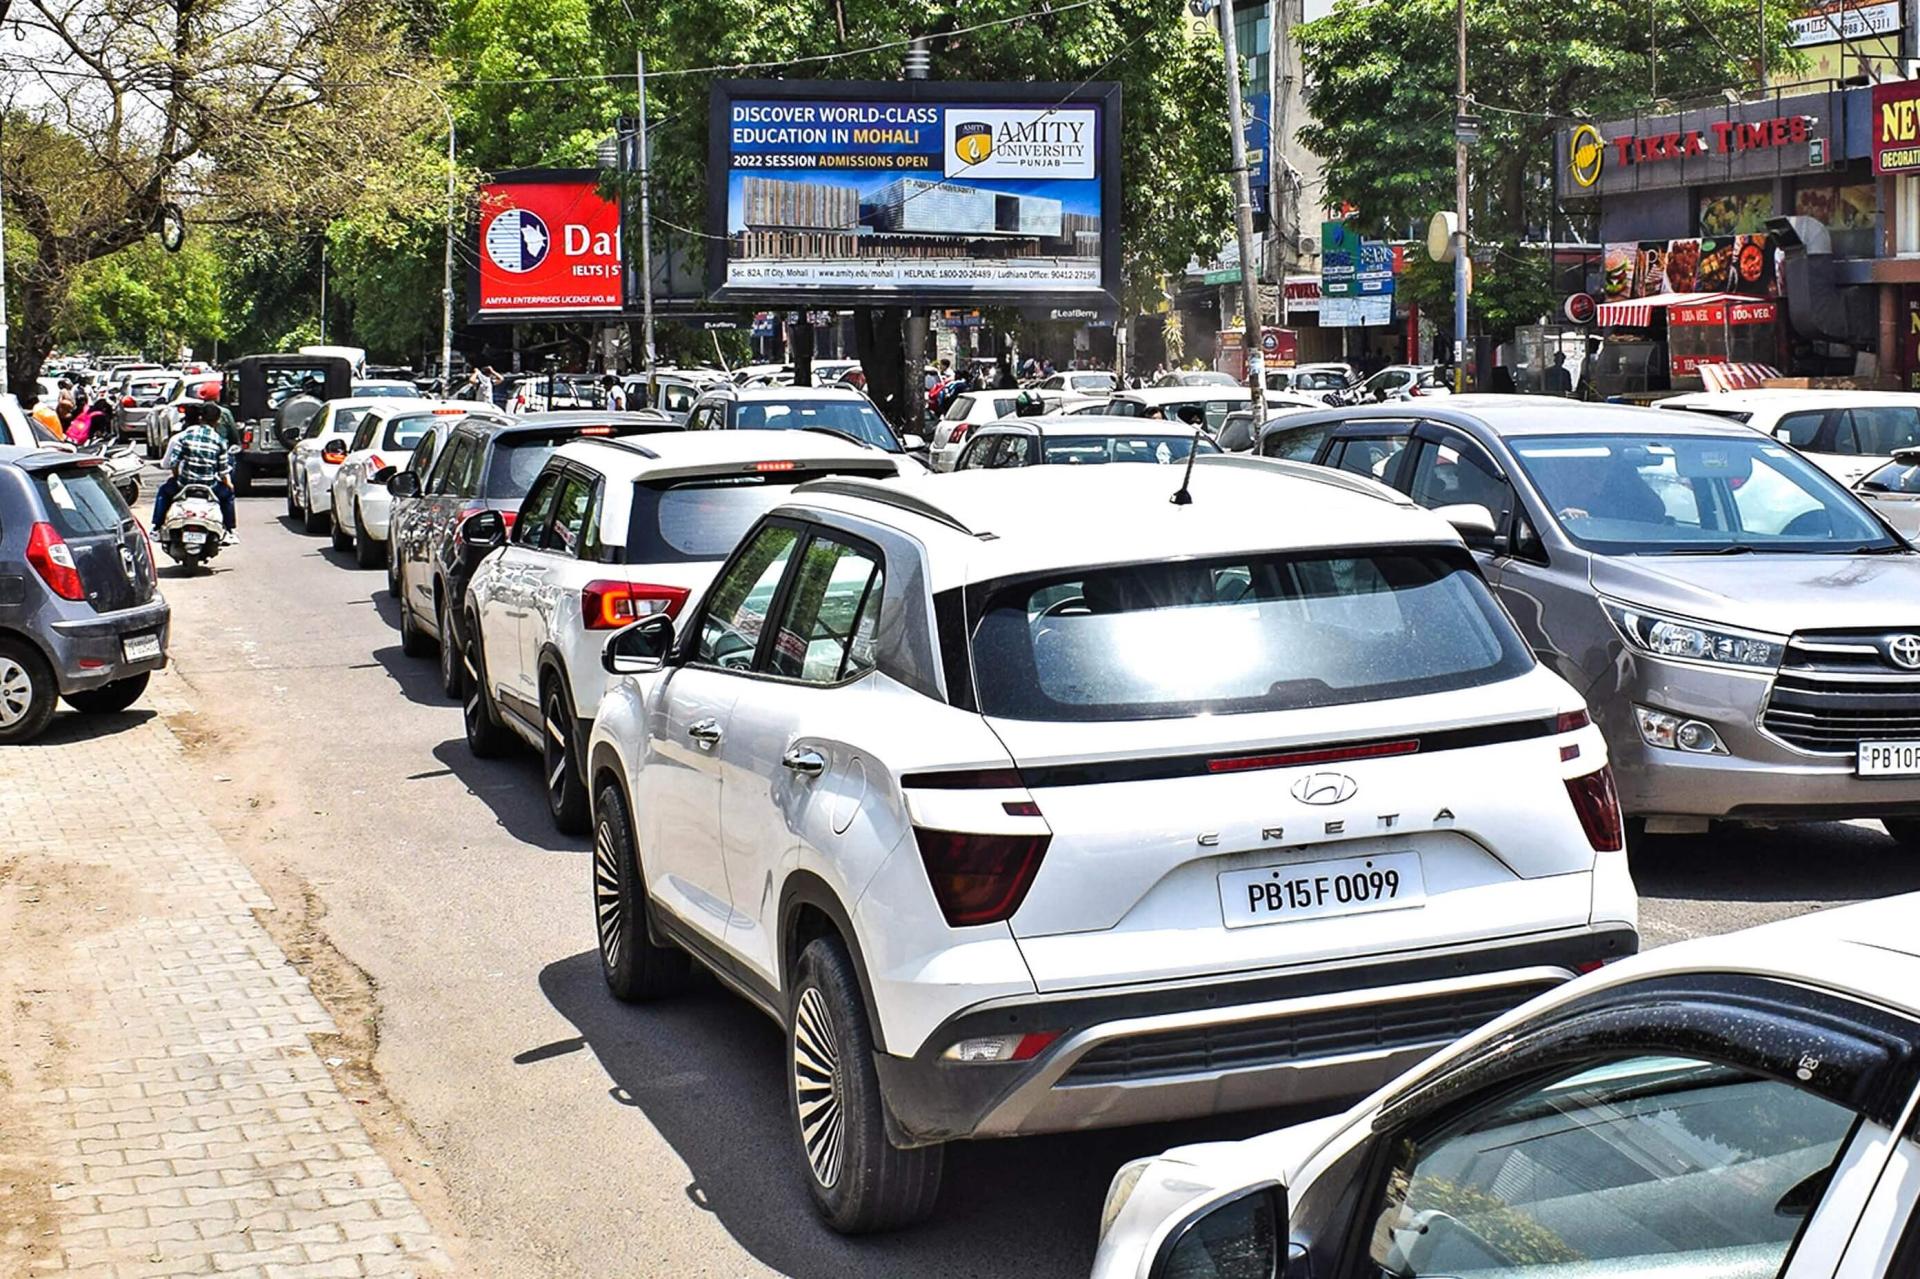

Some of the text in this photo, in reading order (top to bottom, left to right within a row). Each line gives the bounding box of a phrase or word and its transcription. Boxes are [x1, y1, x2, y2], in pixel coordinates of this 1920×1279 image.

[733, 107, 938, 123] DISCOVER WORLD-CLASS
[733, 128, 919, 144] EDUCATION IN MOHALI
[997, 121, 1085, 143] AMITY
[1613, 131, 1704, 167] TIKKA
[1711, 115, 1807, 154] TIMES
[997, 145, 1085, 157] UNIVERSITY
[734, 155, 928, 167] 2022 SESSION ADMISSIONS OPEN
[1020, 159, 1061, 167] PUNJAB
[573, 265, 603, 276] IELTS
[786, 268, 808, 277] Mohali
[998, 270, 1027, 278] Ludhiana
[513, 296, 560, 304] ENTERPRISES
[561, 296, 591, 304] LICENSE
[1057, 309, 1098, 320] LeafBerry
[1197, 807, 1455, 846] CRETA
